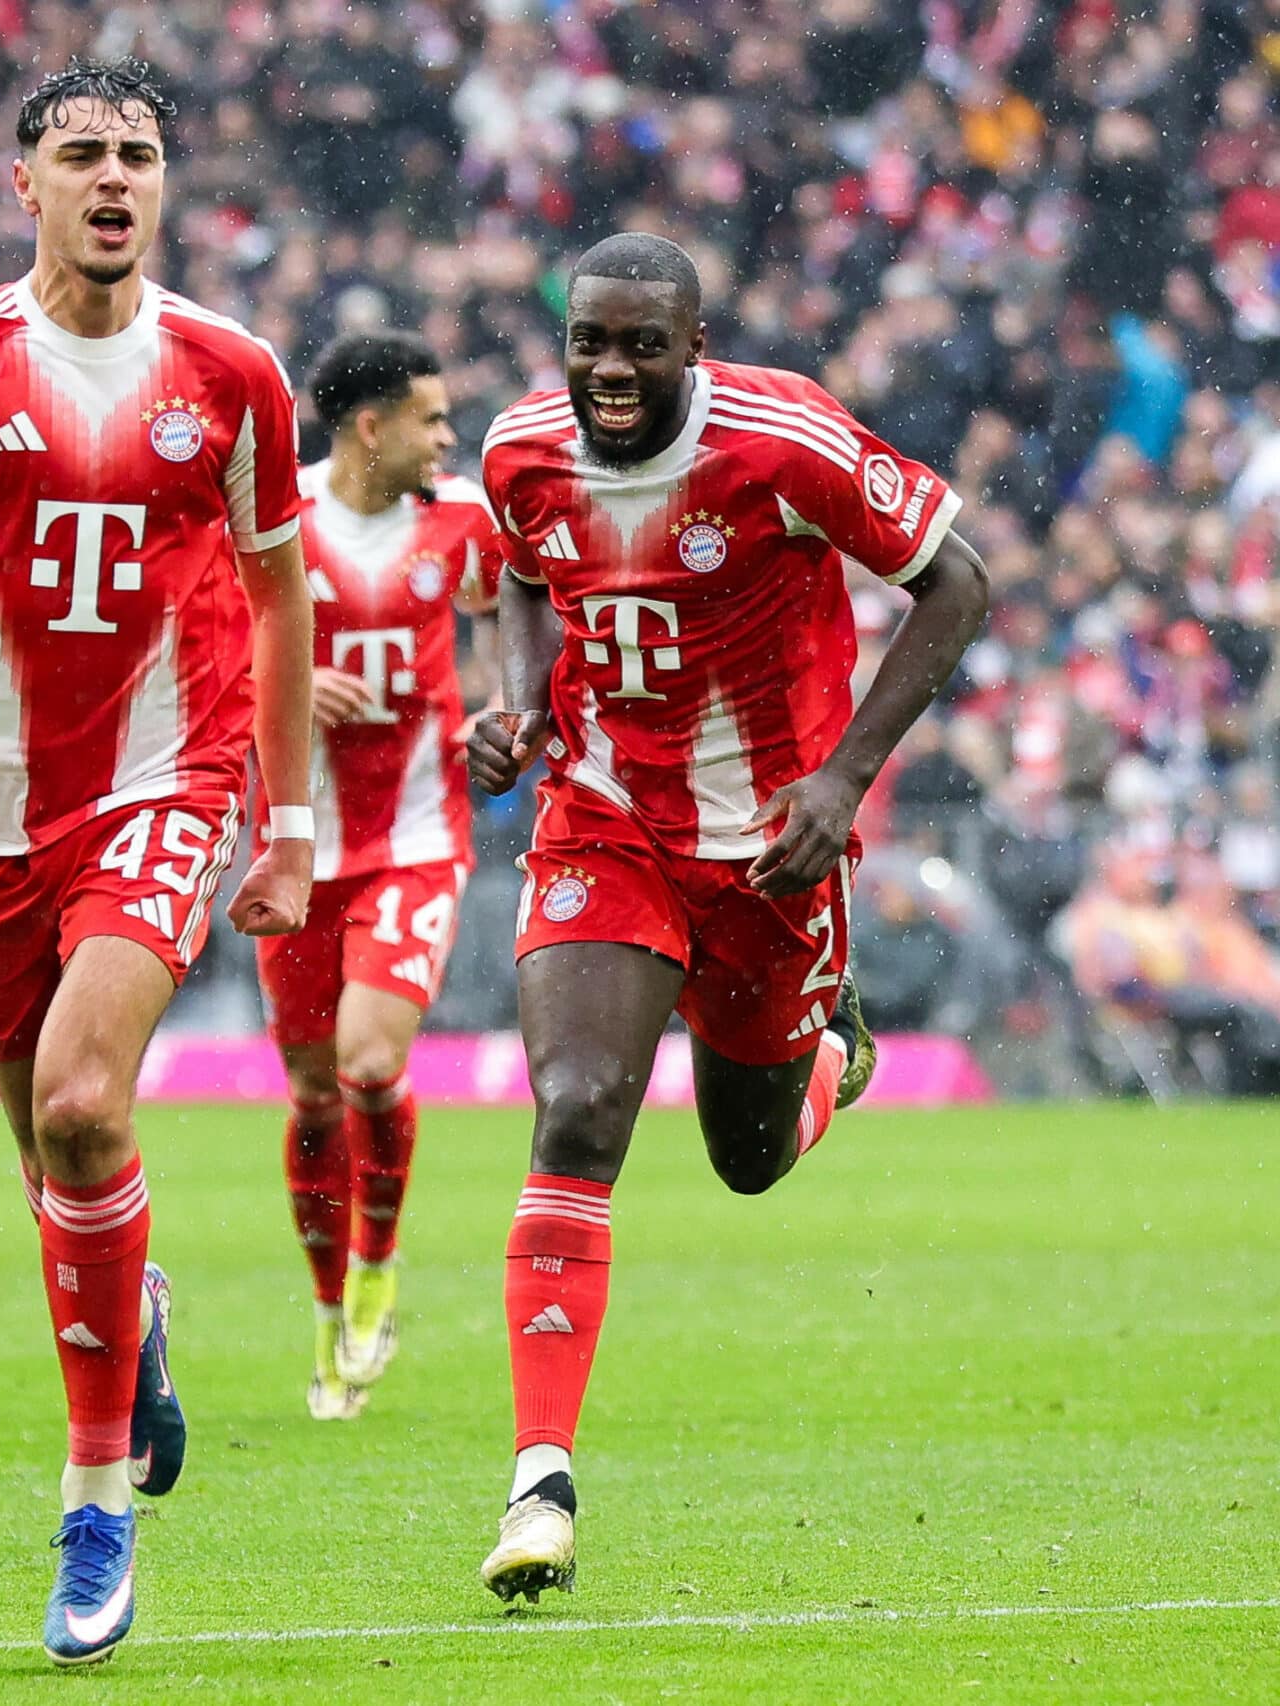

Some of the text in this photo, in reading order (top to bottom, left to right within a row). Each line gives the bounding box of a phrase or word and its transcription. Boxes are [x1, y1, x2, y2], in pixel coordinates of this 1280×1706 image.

[692, 527, 722, 547] BAYERN
[899, 475, 935, 539] Allianz
[30, 499, 147, 634] T
[582, 595, 681, 701] T
[100, 808, 212, 896] 45
[371, 885, 454, 946] 14
[800, 905, 839, 996] 2
